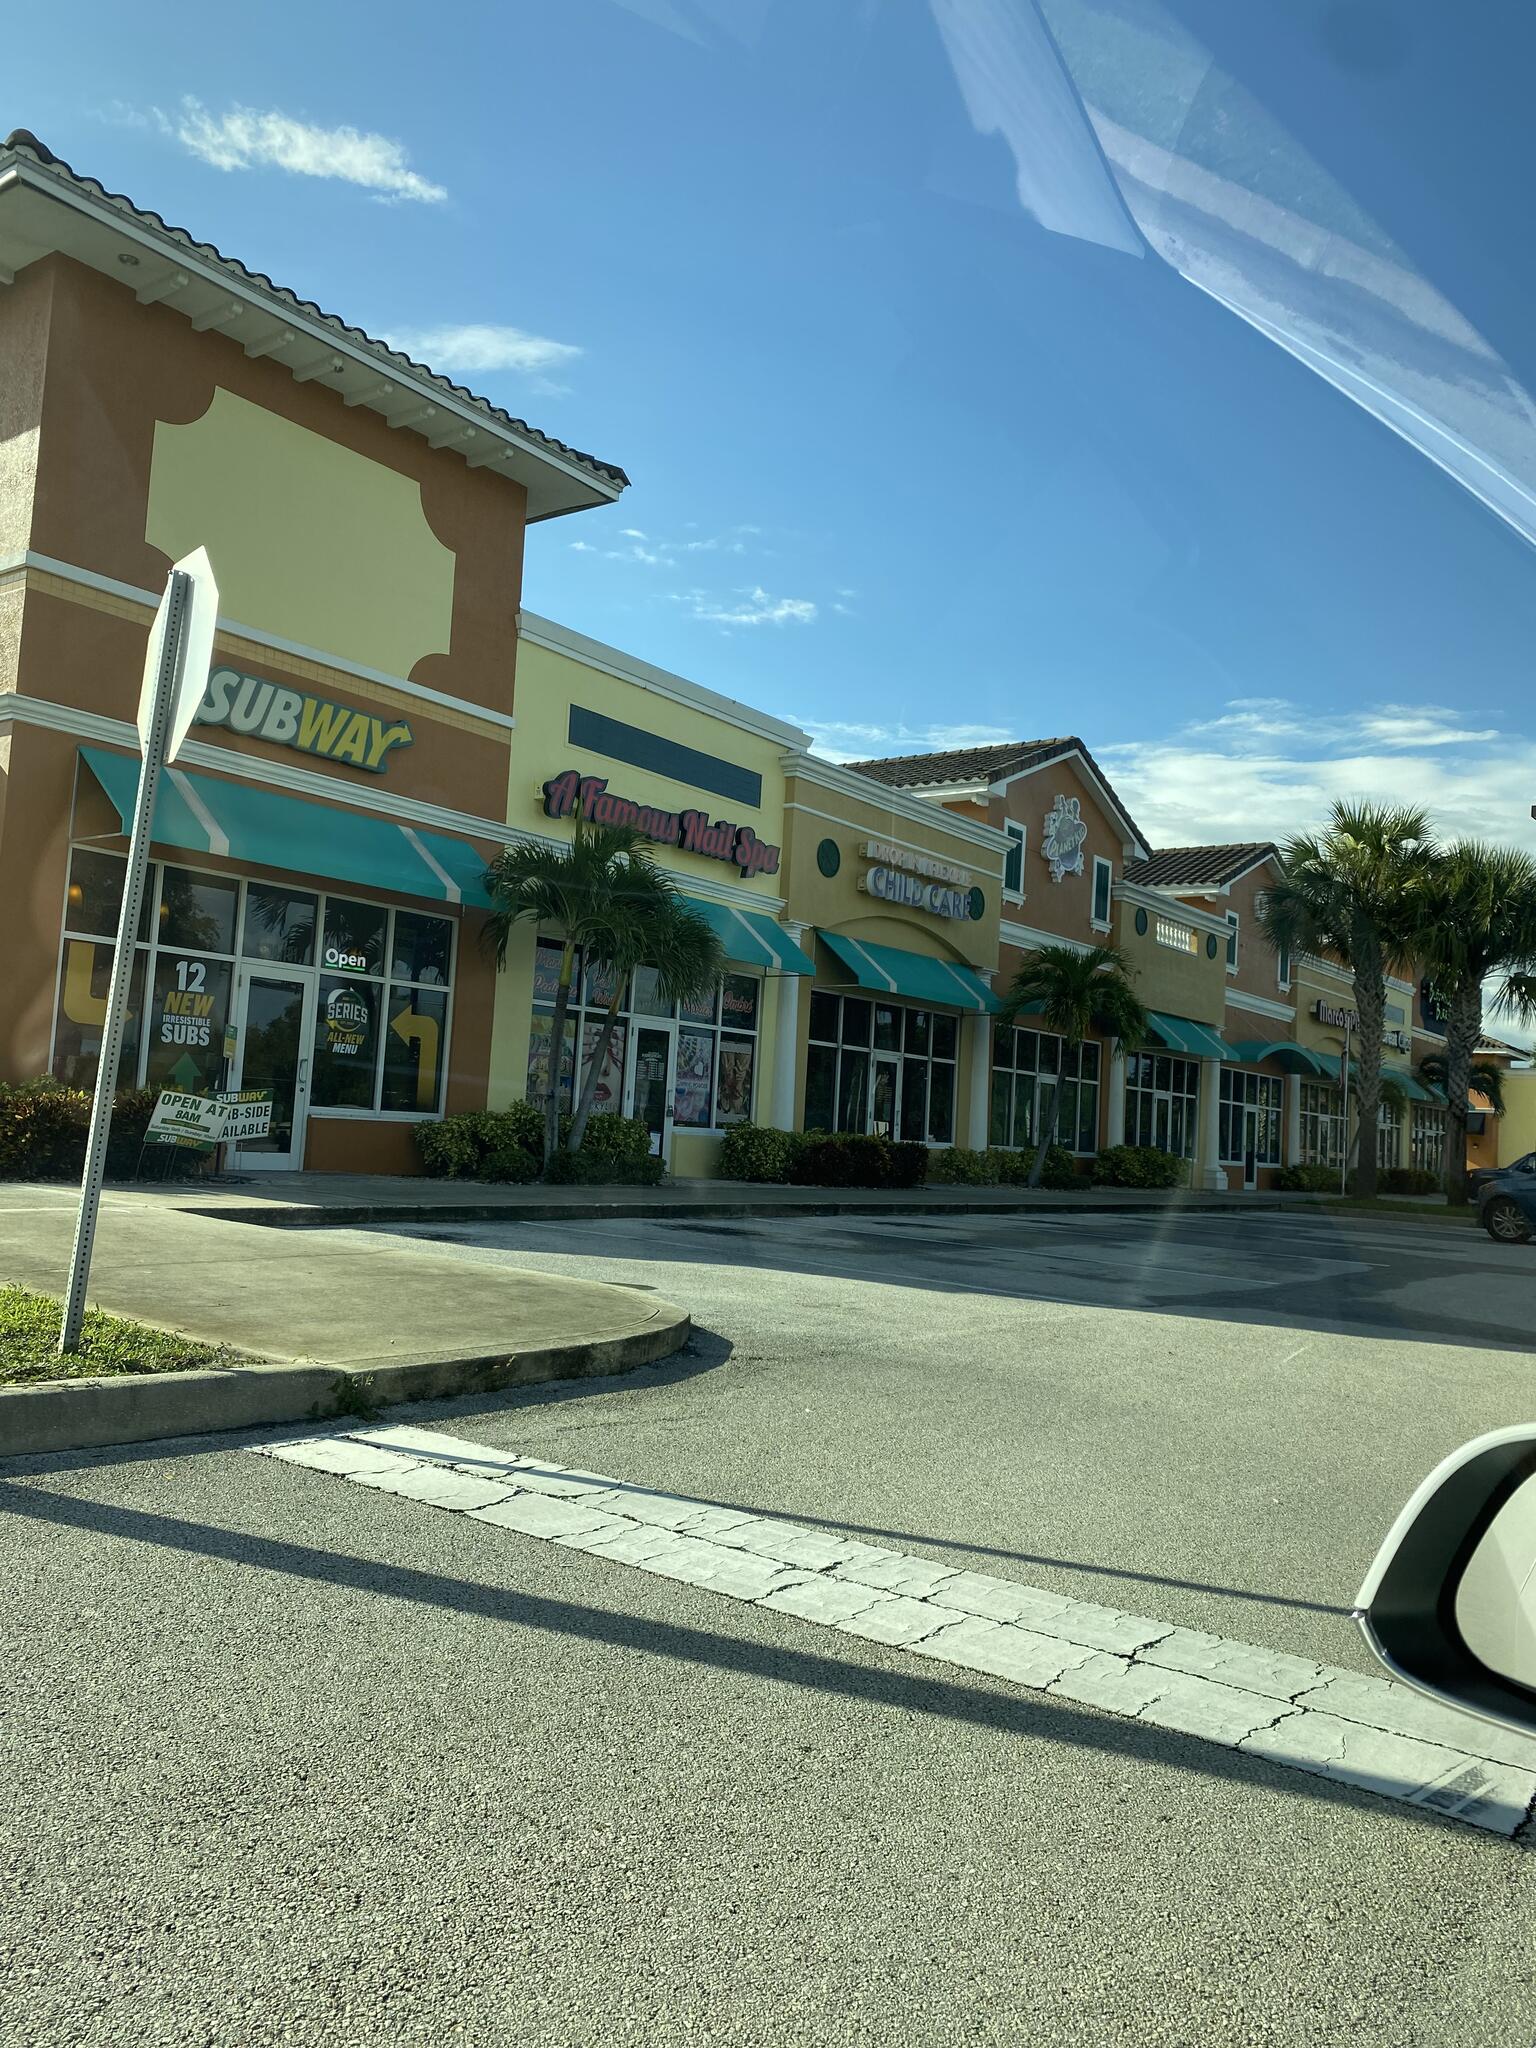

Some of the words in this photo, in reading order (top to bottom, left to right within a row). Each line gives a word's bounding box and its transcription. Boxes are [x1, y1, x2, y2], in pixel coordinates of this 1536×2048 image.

[196, 671, 413, 767] SUBWAY
[545, 771, 580, 818] A
[580, 777, 681, 843] Famous
[680, 809, 736, 860] Nail
[735, 827, 780, 878] Spa
[867, 866, 923, 907] CHILD
[924, 884, 971, 920] CARE
[325, 948, 366, 968] Open
[176, 961, 206, 993] 12
[164, 992, 215, 1017] NEW
[328, 1003, 368, 1024] SERIES
[163, 1014, 211, 1027] IRRESISTIBLE
[161, 1023, 210, 1046] SUBS
[328, 1032, 365, 1045] ALL-NEW
[332, 1043, 358, 1055] MENU
[161, 1093, 202, 1111] OPEN
[205, 1104, 228, 1118] AT
[216, 1090, 268, 1104] SUBWAY
[175, 1110, 201, 1123] 8AM
[157, 1134, 204, 1147] SUBWAY
